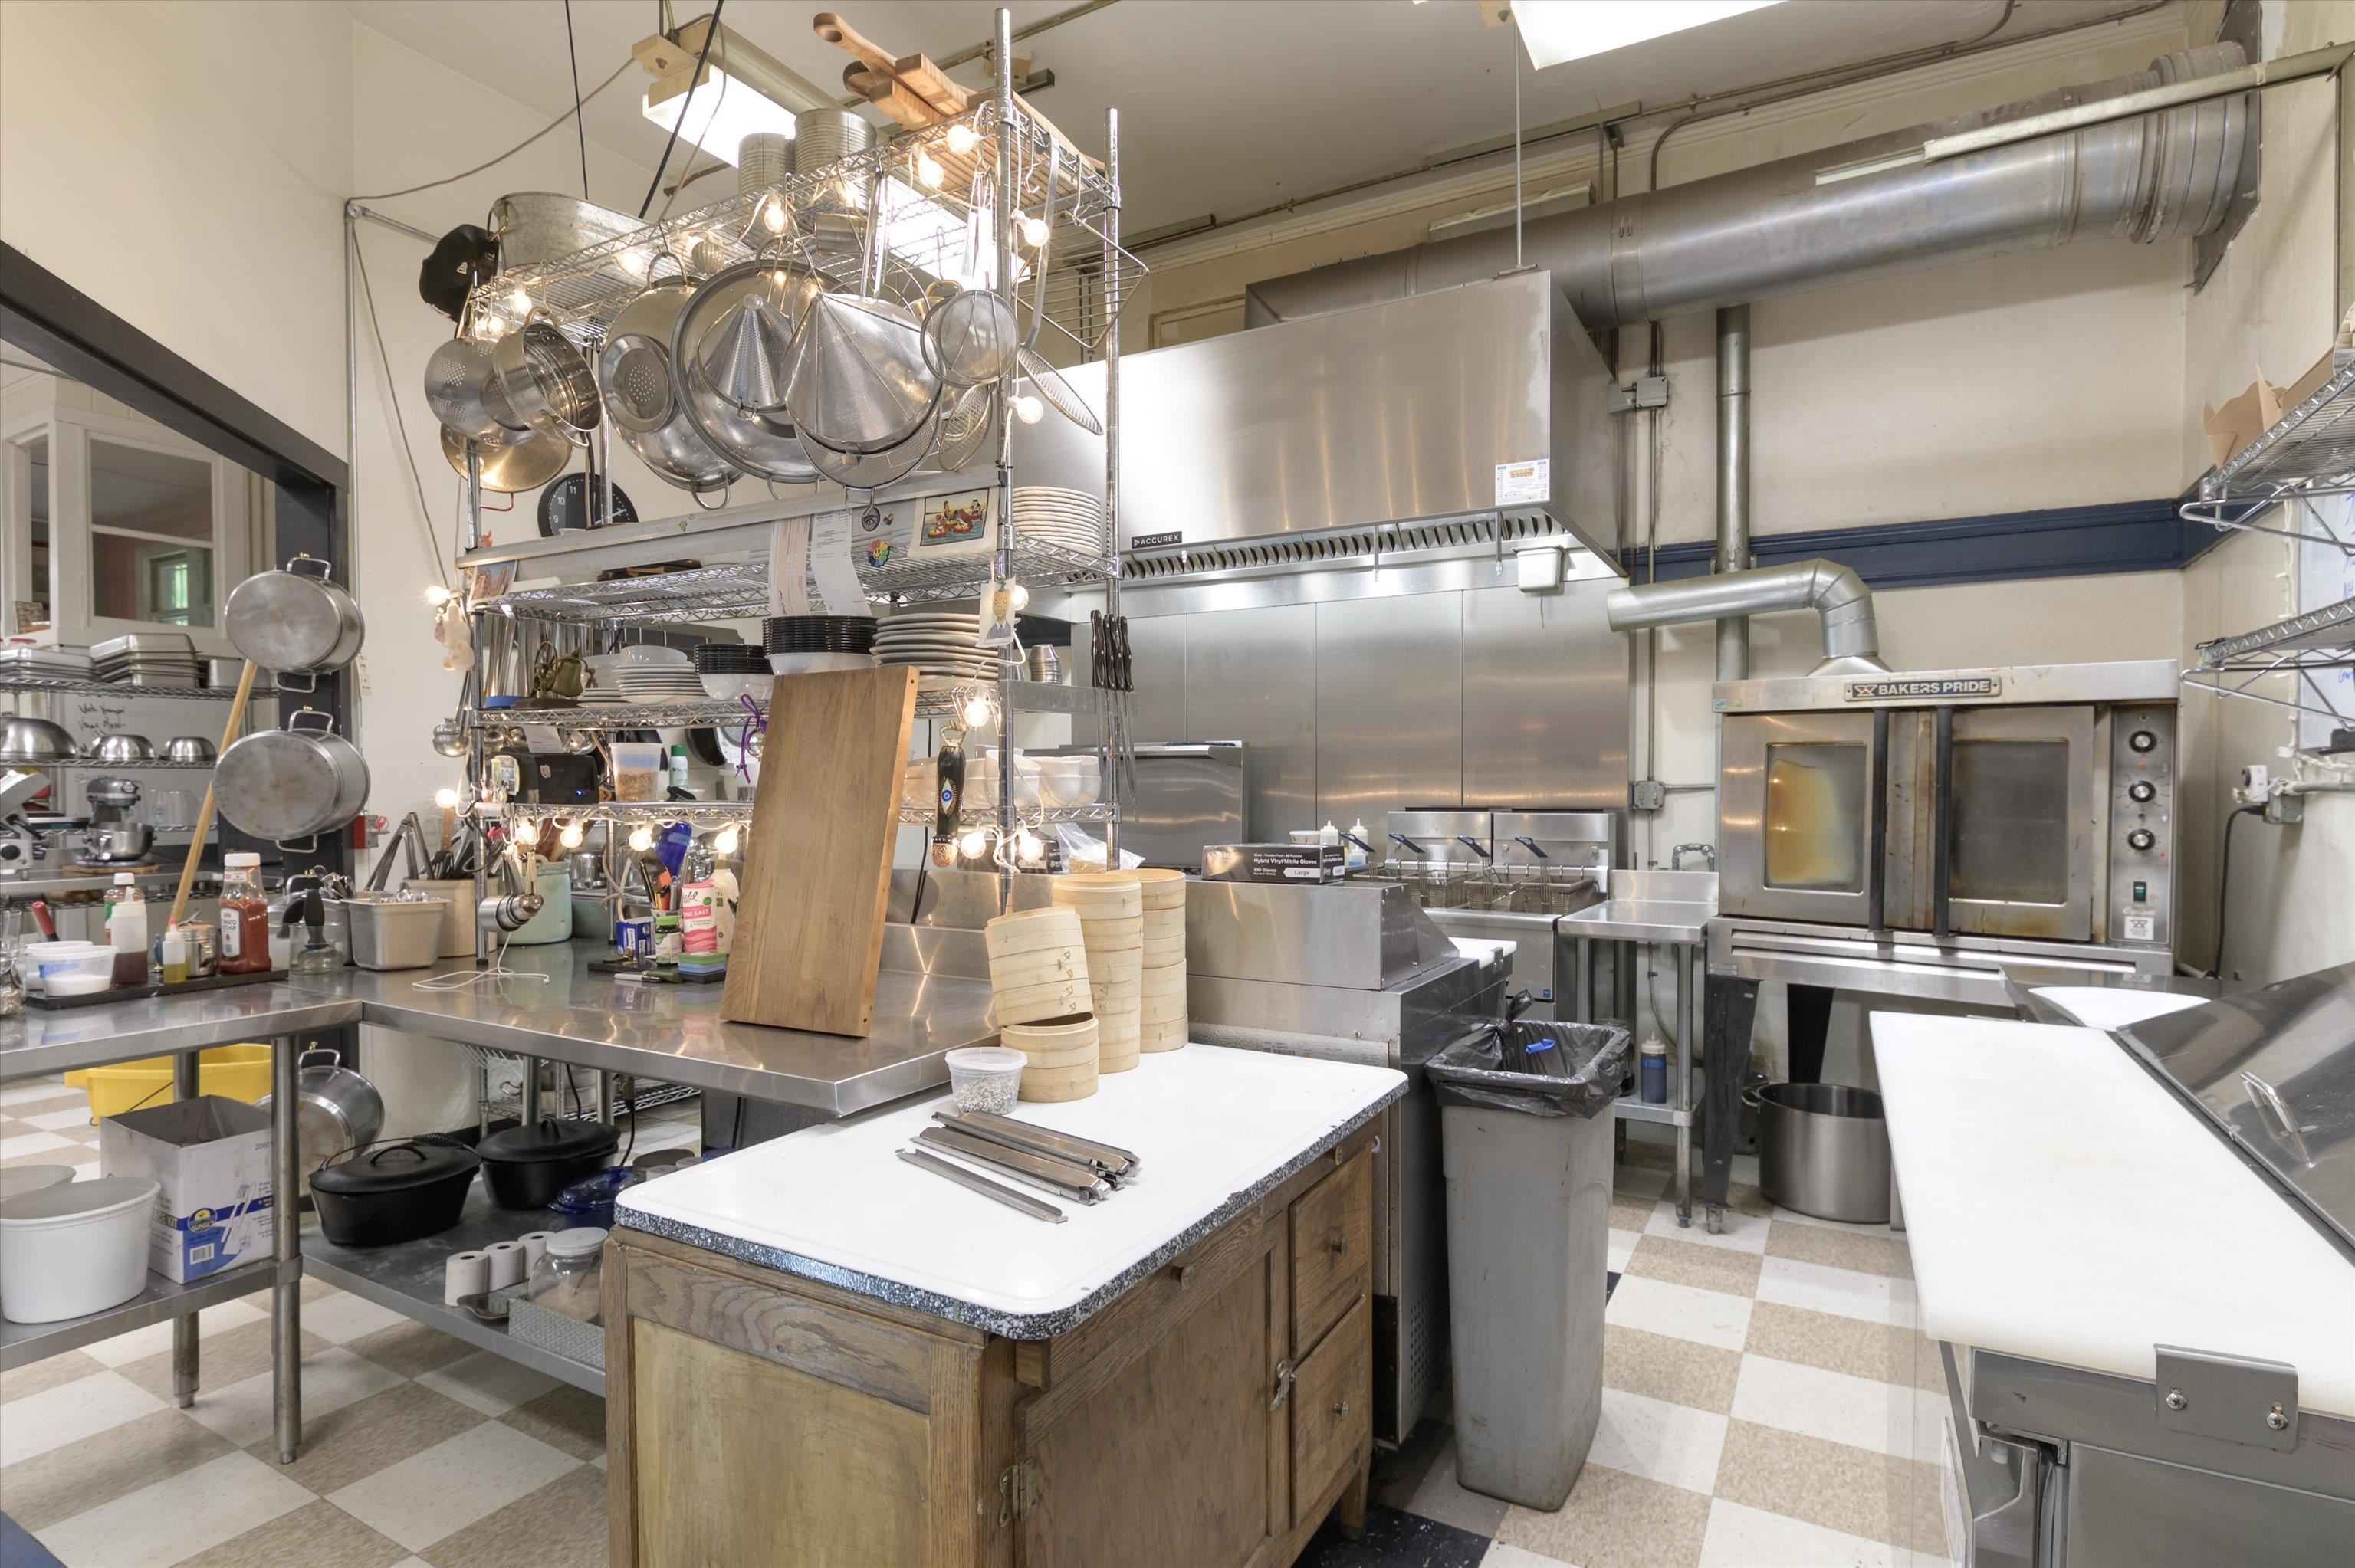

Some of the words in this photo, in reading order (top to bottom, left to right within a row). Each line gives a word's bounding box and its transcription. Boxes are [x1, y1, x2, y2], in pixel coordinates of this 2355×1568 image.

[570, 486, 576, 494] 11
[557, 497, 566, 506] 10
[553, 515, 559, 523] 9
[1141, 534, 1179, 545] ACCUREX
[1878, 682, 1940, 695] BAKERS
[1943, 680, 1990, 693] PRIDE
